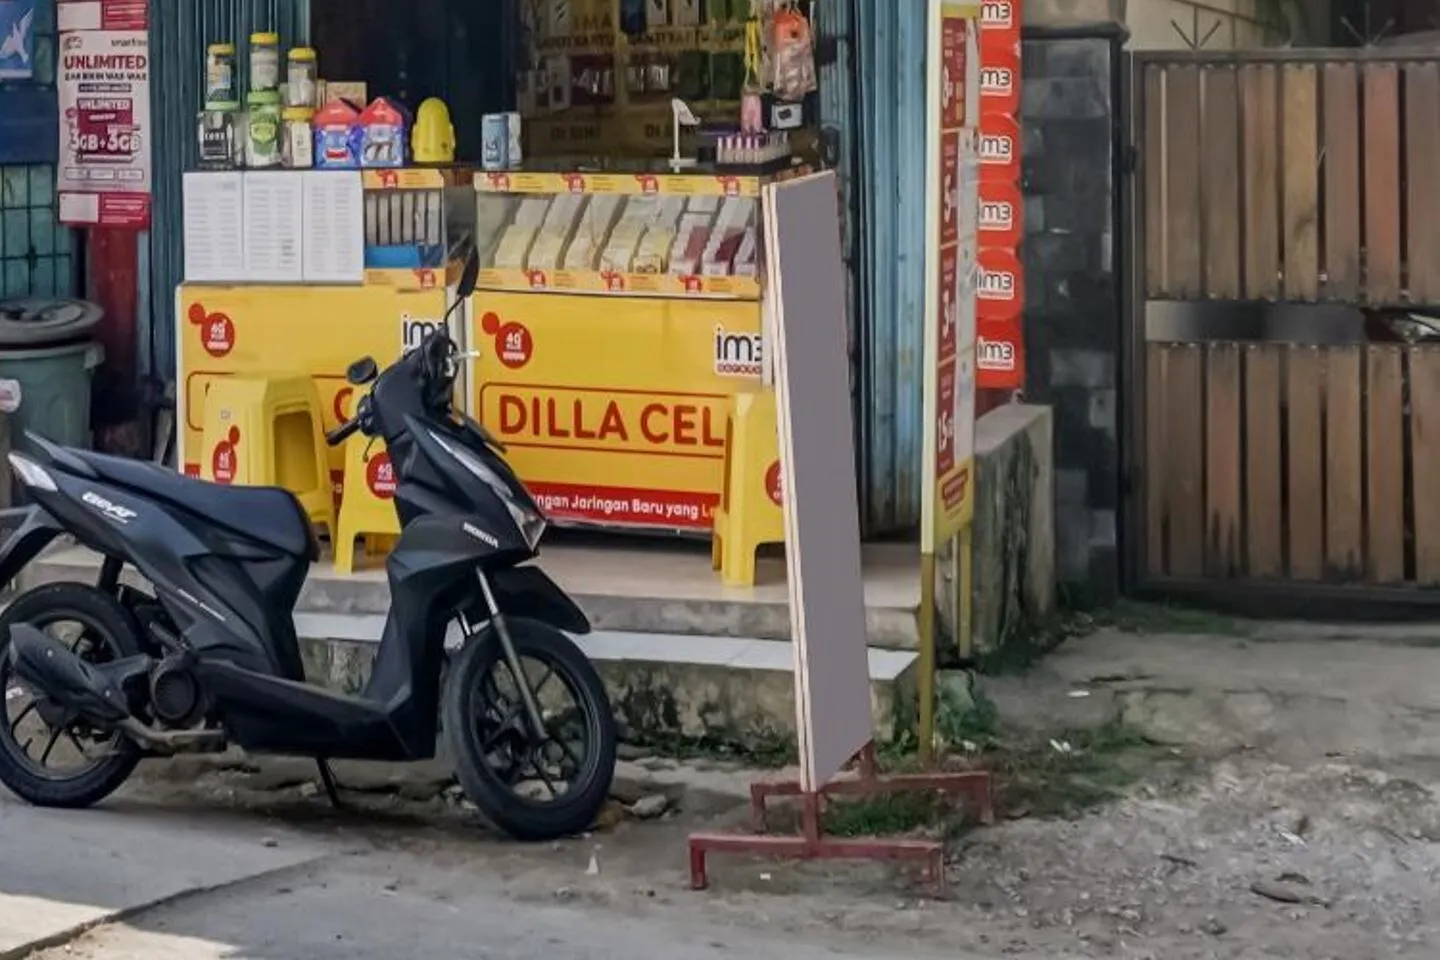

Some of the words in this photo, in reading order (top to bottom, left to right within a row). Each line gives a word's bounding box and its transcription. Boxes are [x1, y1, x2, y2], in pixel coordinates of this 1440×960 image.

[981, 3, 1010, 19] m3
[64, 54, 147, 70] UNLIMITED
[980, 70, 1010, 86] m3
[981, 137, 1010, 154] m3
[403, 314, 445, 345] im
[499, 394, 629, 441] DILLA
[640, 403, 725, 447] CEL
[533, 494, 569, 510] ngan
[571, 494, 629, 514] Jaringan
[632, 498, 664, 515] Baru
[666, 504, 699, 520] yang
